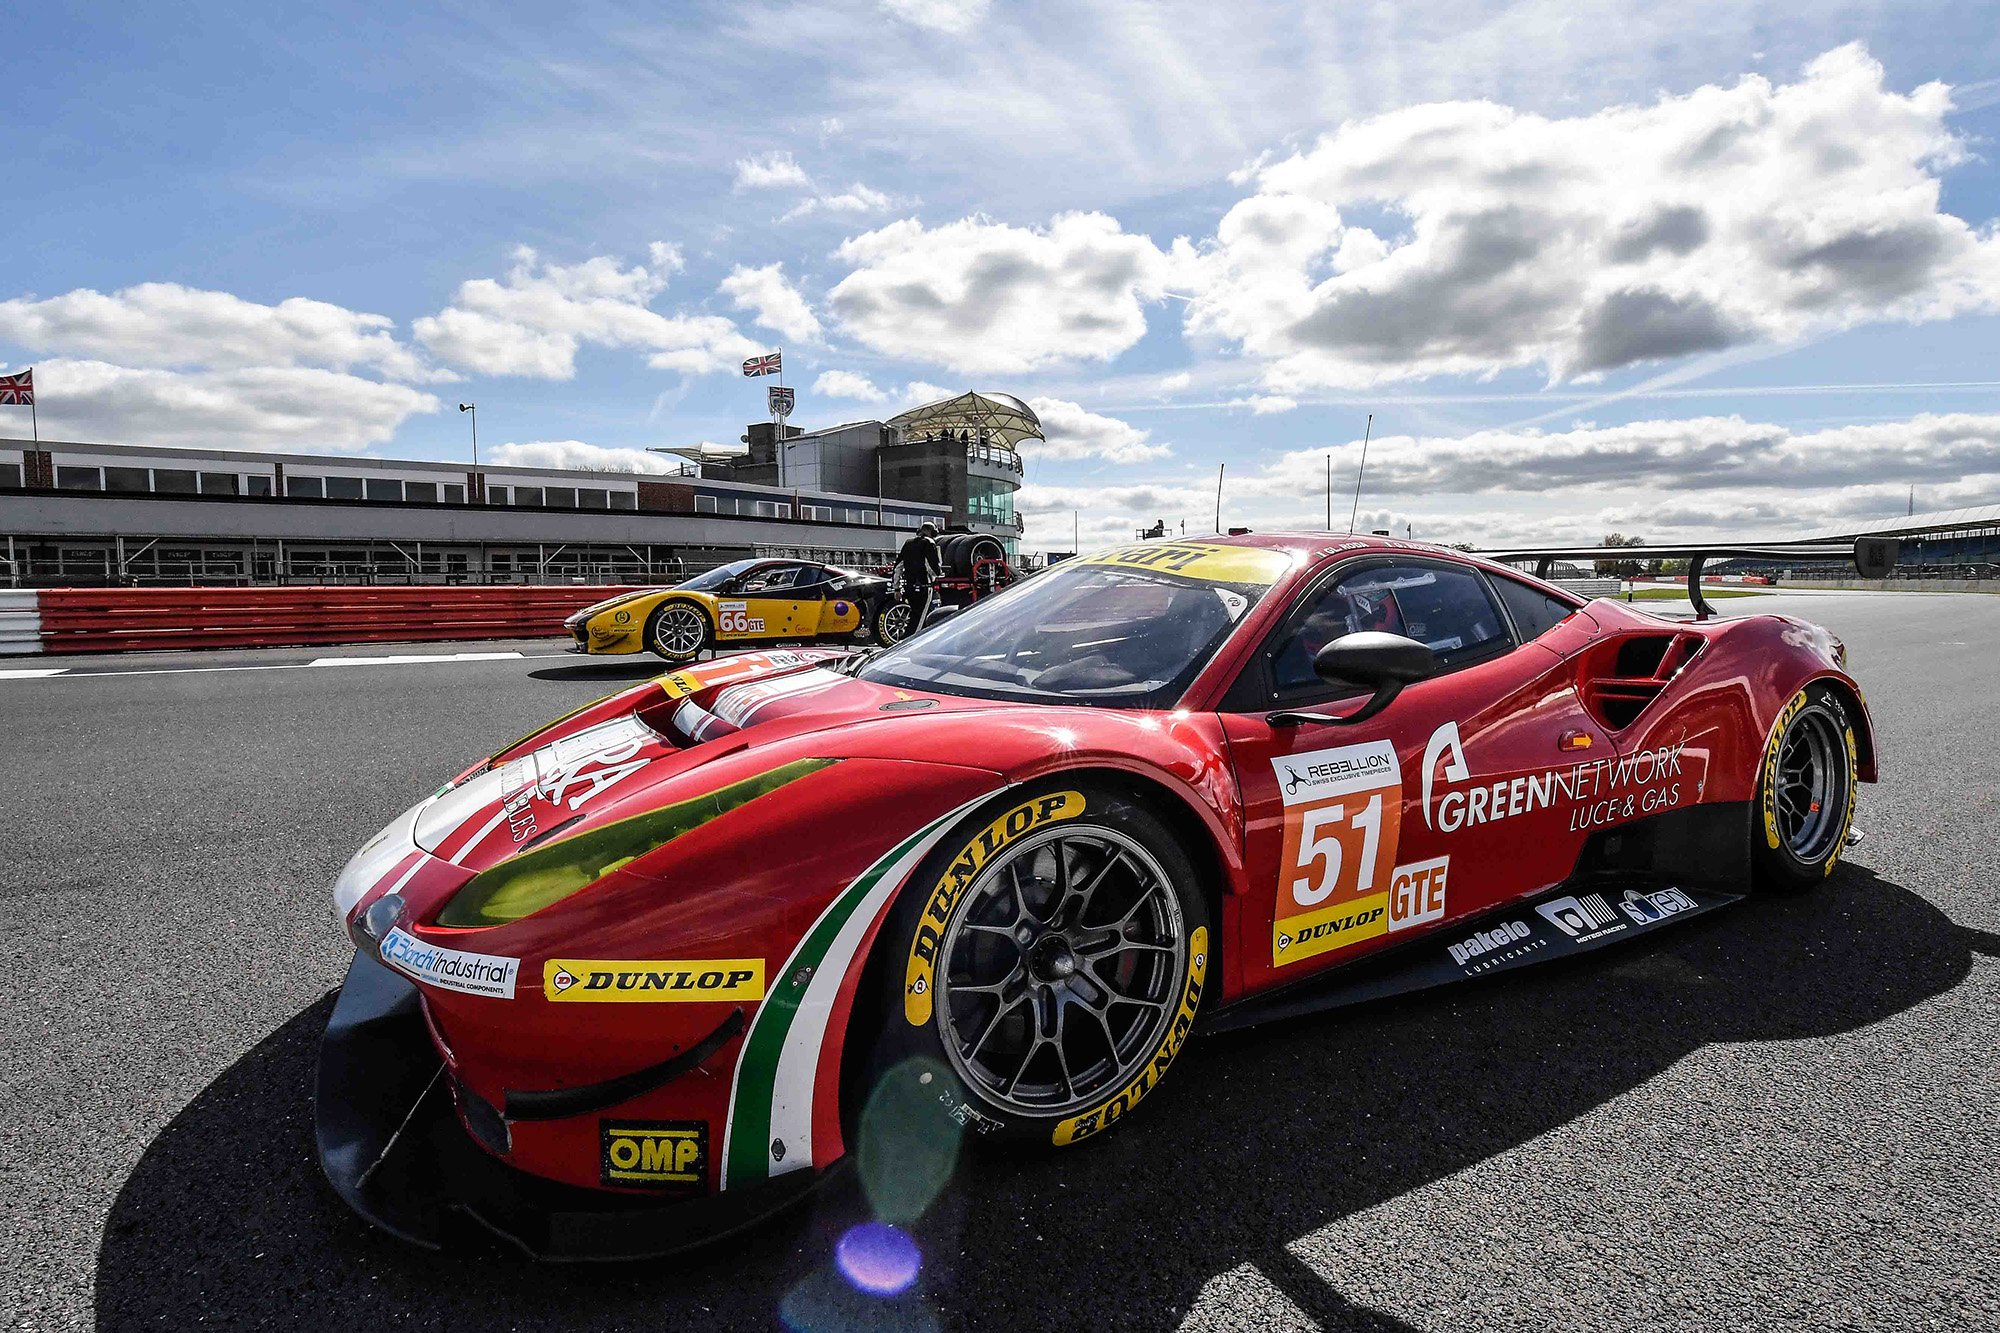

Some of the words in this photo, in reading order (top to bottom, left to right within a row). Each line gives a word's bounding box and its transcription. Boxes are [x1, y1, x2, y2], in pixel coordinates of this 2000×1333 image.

[719, 611, 748, 632] 66
[749, 620, 765, 631] GTE
[1312, 778, 1330, 786] SWISS
[1330, 772, 1361, 783] EXCLUSIVE
[1361, 766, 1392, 777] TIMEPIECES
[1569, 798, 1619, 832] LUCE
[1621, 794, 1635, 818] &
[1641, 782, 1681, 813] GAS
[1292, 794, 1383, 907] 51
[915, 794, 1067, 969] DUNLOP
[1391, 866, 1446, 922] GTE
[1295, 907, 1385, 945] DUNLOP
[1447, 919, 1531, 966] pakelo
[1602, 923, 1628, 936] RACING
[1465, 939, 1547, 976] LUBRICANTS
[440, 978, 466, 989] INDUSTRIAL
[466, 983, 504, 995] COMPONENTS
[583, 970, 754, 990] DUNLOP
[610, 1138, 699, 1171] OMP
